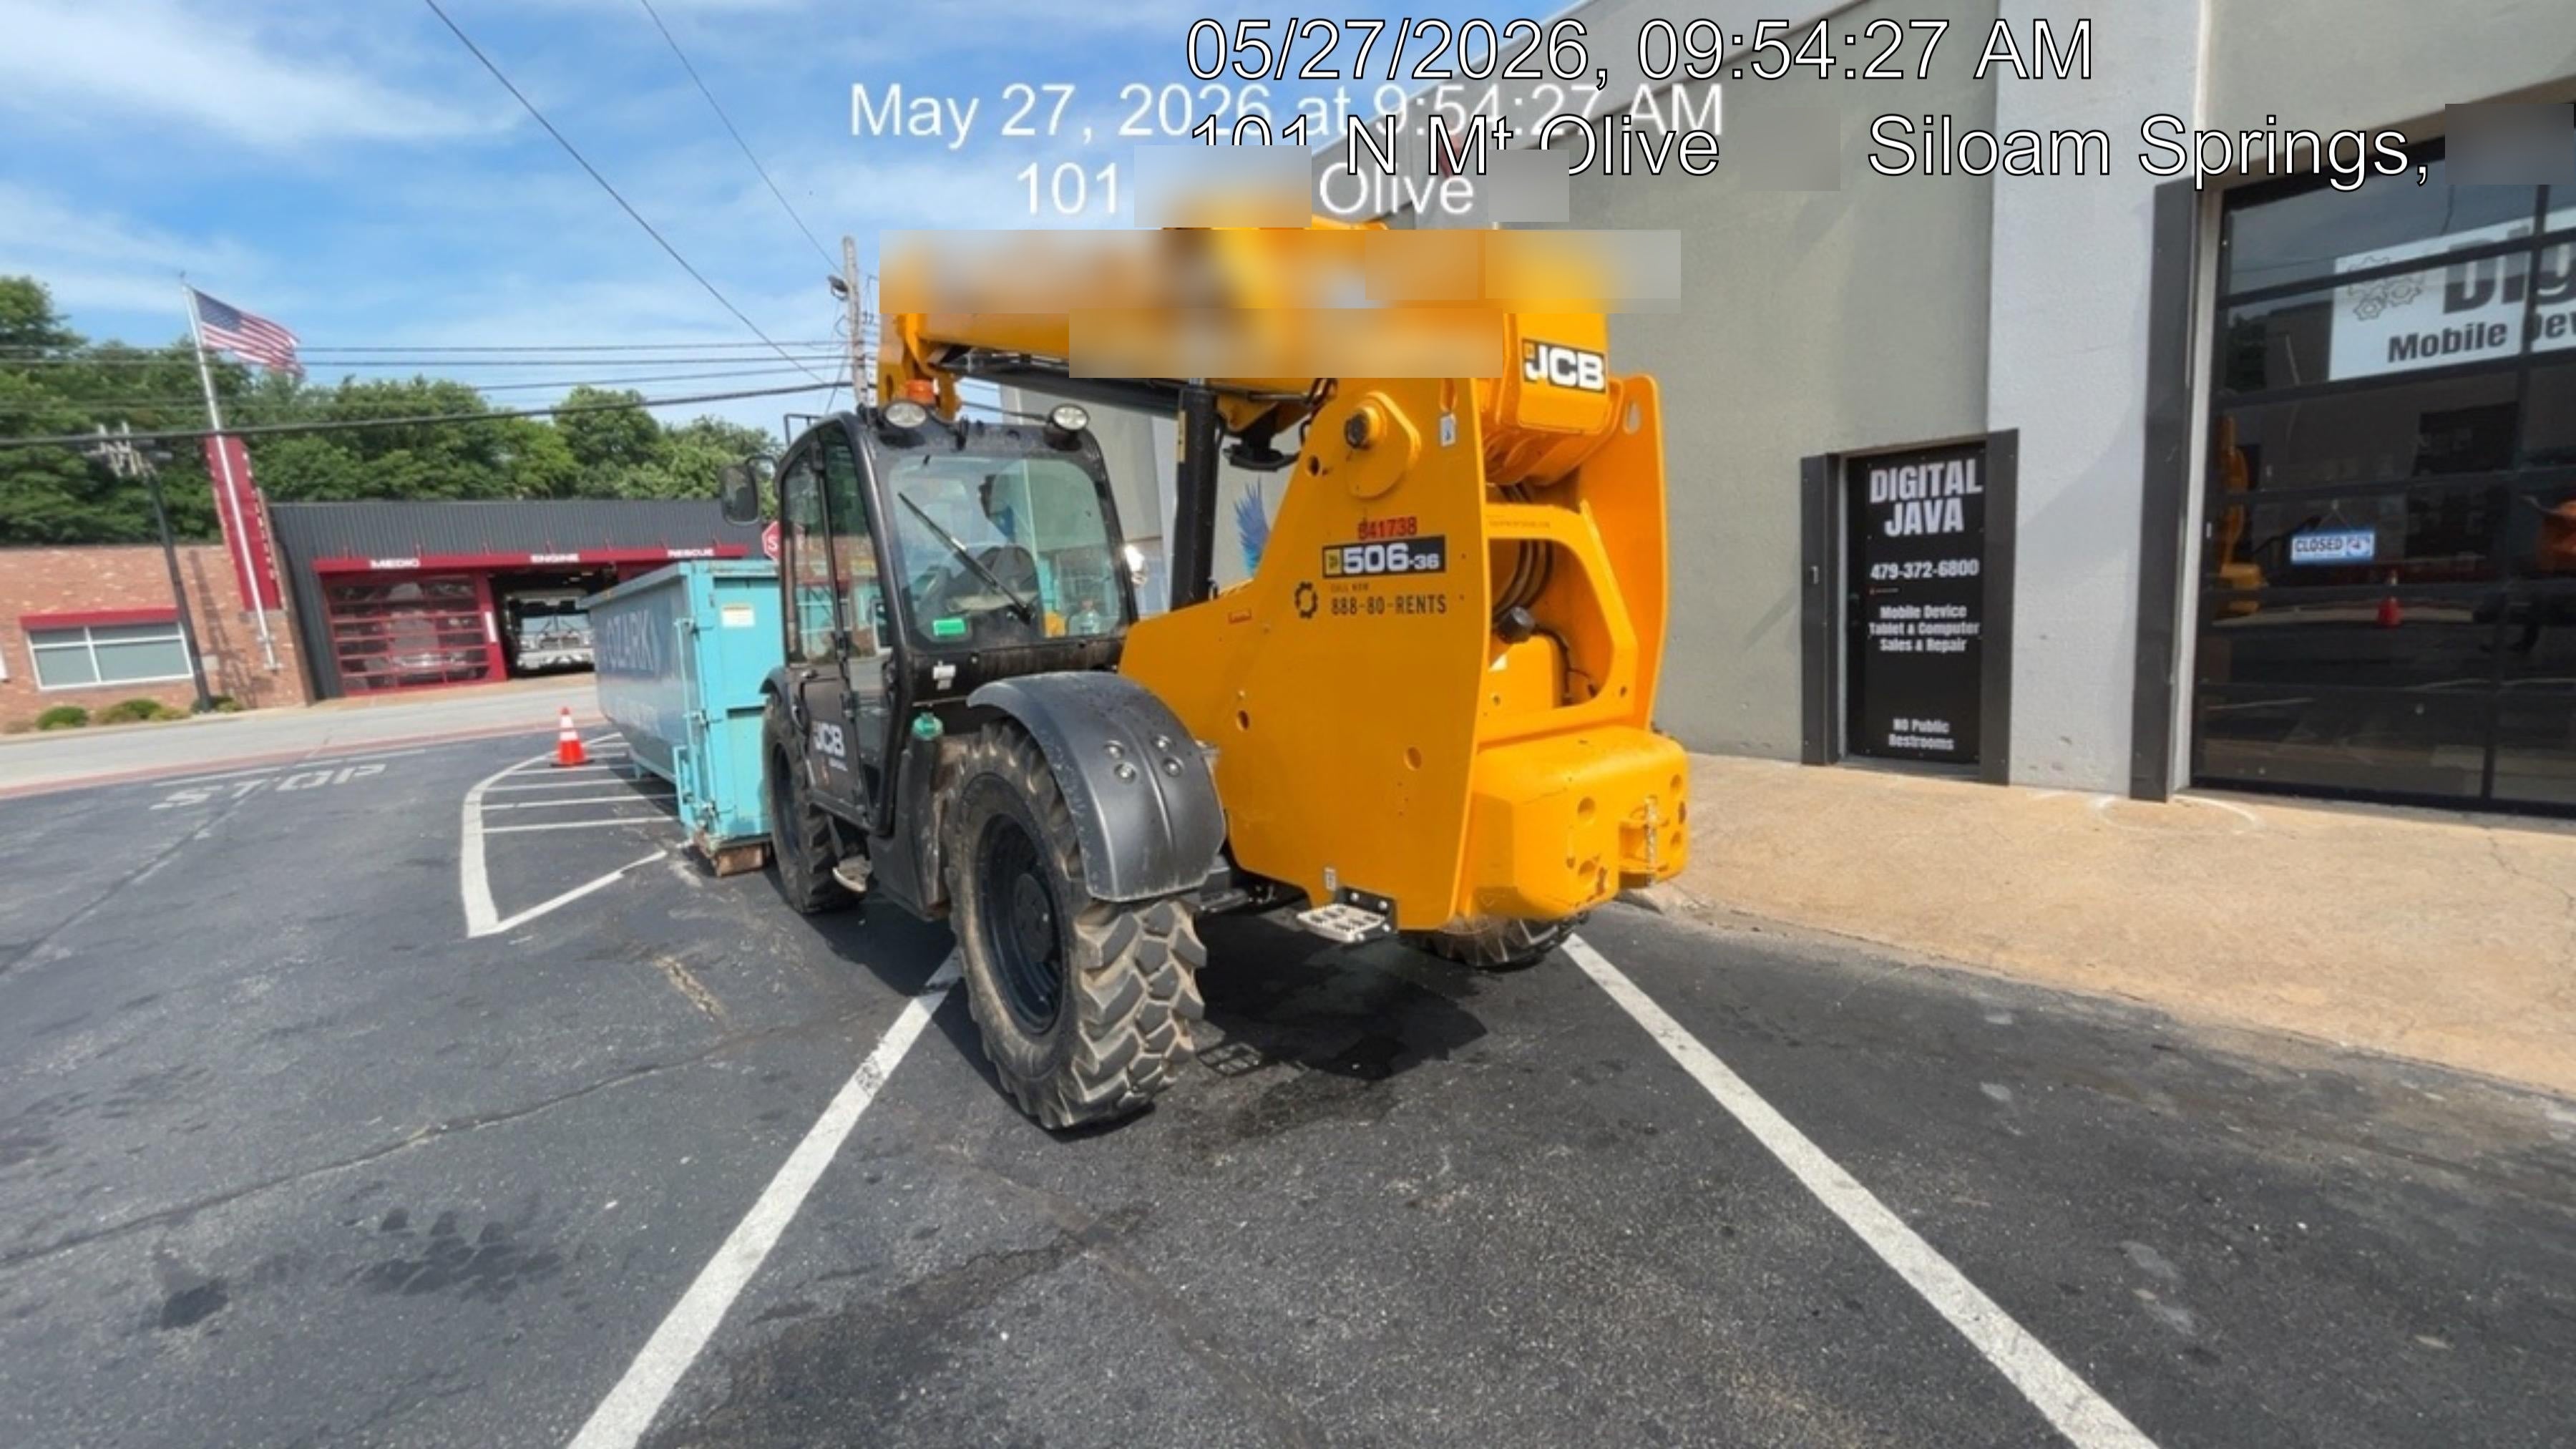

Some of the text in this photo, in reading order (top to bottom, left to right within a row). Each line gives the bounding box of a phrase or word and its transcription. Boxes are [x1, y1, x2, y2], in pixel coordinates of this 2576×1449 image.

[2388, 322, 2508, 363] Mobile
[1524, 343, 1606, 391] JCB
[1869, 459, 1984, 504] DIGITAL
[1884, 497, 1964, 537] JAVA
[667, 548, 714, 557] RESCUE
[2296, 537, 2343, 552] CLOSED
[370, 557, 421, 569] MEDIC
[530, 553, 580, 564] ENGINE
[1343, 542, 1440, 574] 506-36
[1870, 558, 1981, 581] 479-372-6800
[1330, 593, 1447, 615] 888-80-RENTS
[1879, 605, 1968, 620] Mobile Device
[1869, 622, 1906, 635] Tablet
[1918, 622, 1981, 636] Computer
[1879, 638, 1913, 652] Sales
[1926, 638, 1968, 653] Repair
[1911, 718, 1951, 733] Public
[812, 722, 844, 756] JCB
[1888, 733, 1955, 750] Restrooms
[148, 763, 386, 810] STOP
